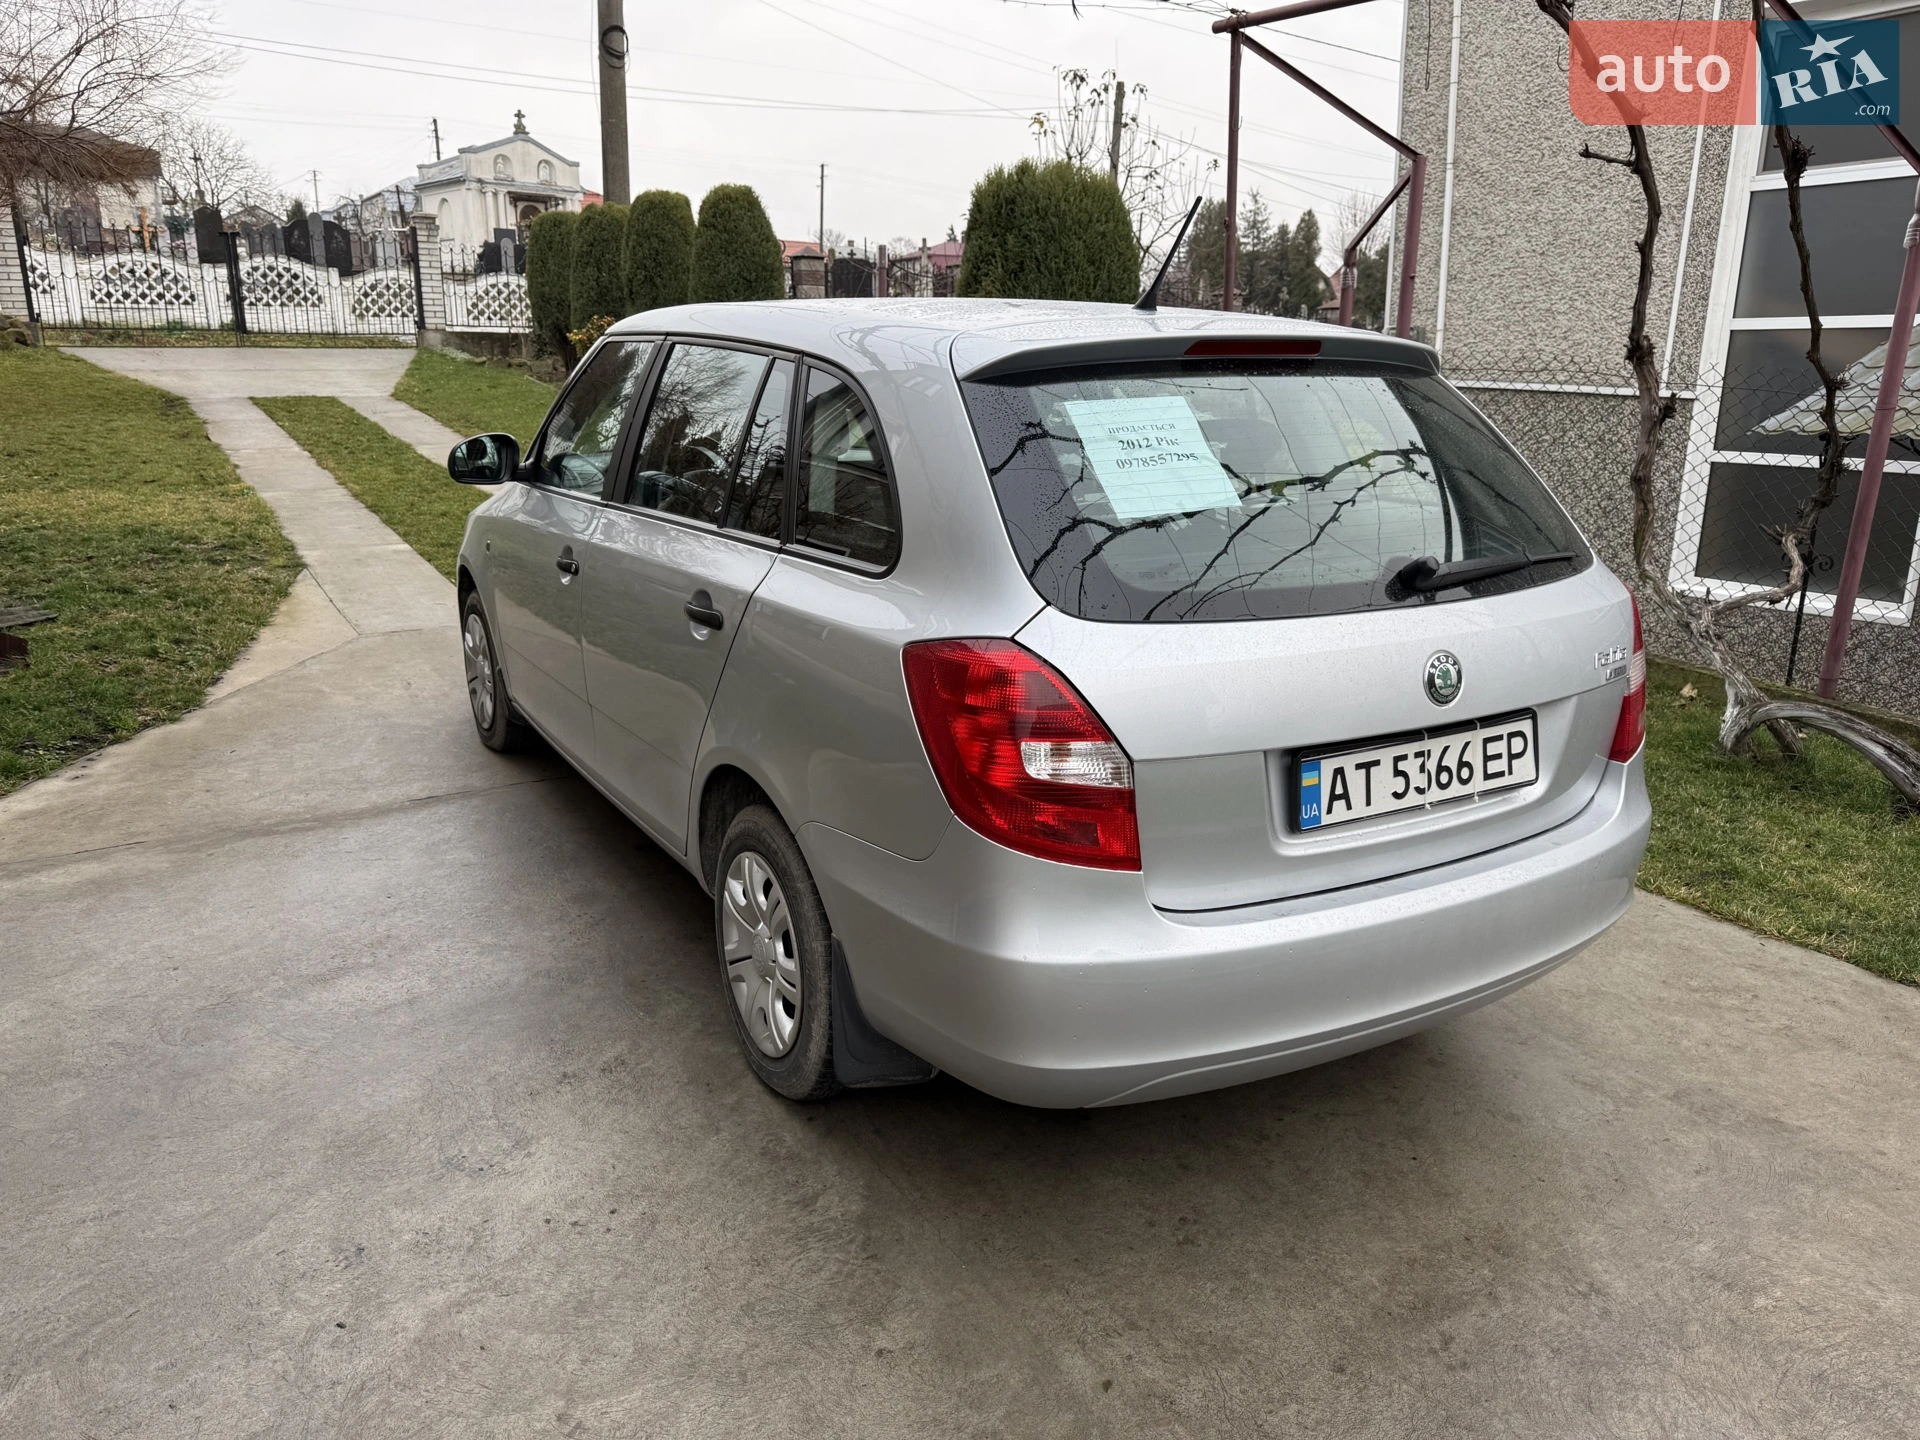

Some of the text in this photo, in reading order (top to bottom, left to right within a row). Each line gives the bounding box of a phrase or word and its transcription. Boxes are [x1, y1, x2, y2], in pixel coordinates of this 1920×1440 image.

[1118, 436, 1180, 451] 2012 Рік
[1115, 453, 1199, 470] 0978557295
[1302, 803, 1319, 819] UA
